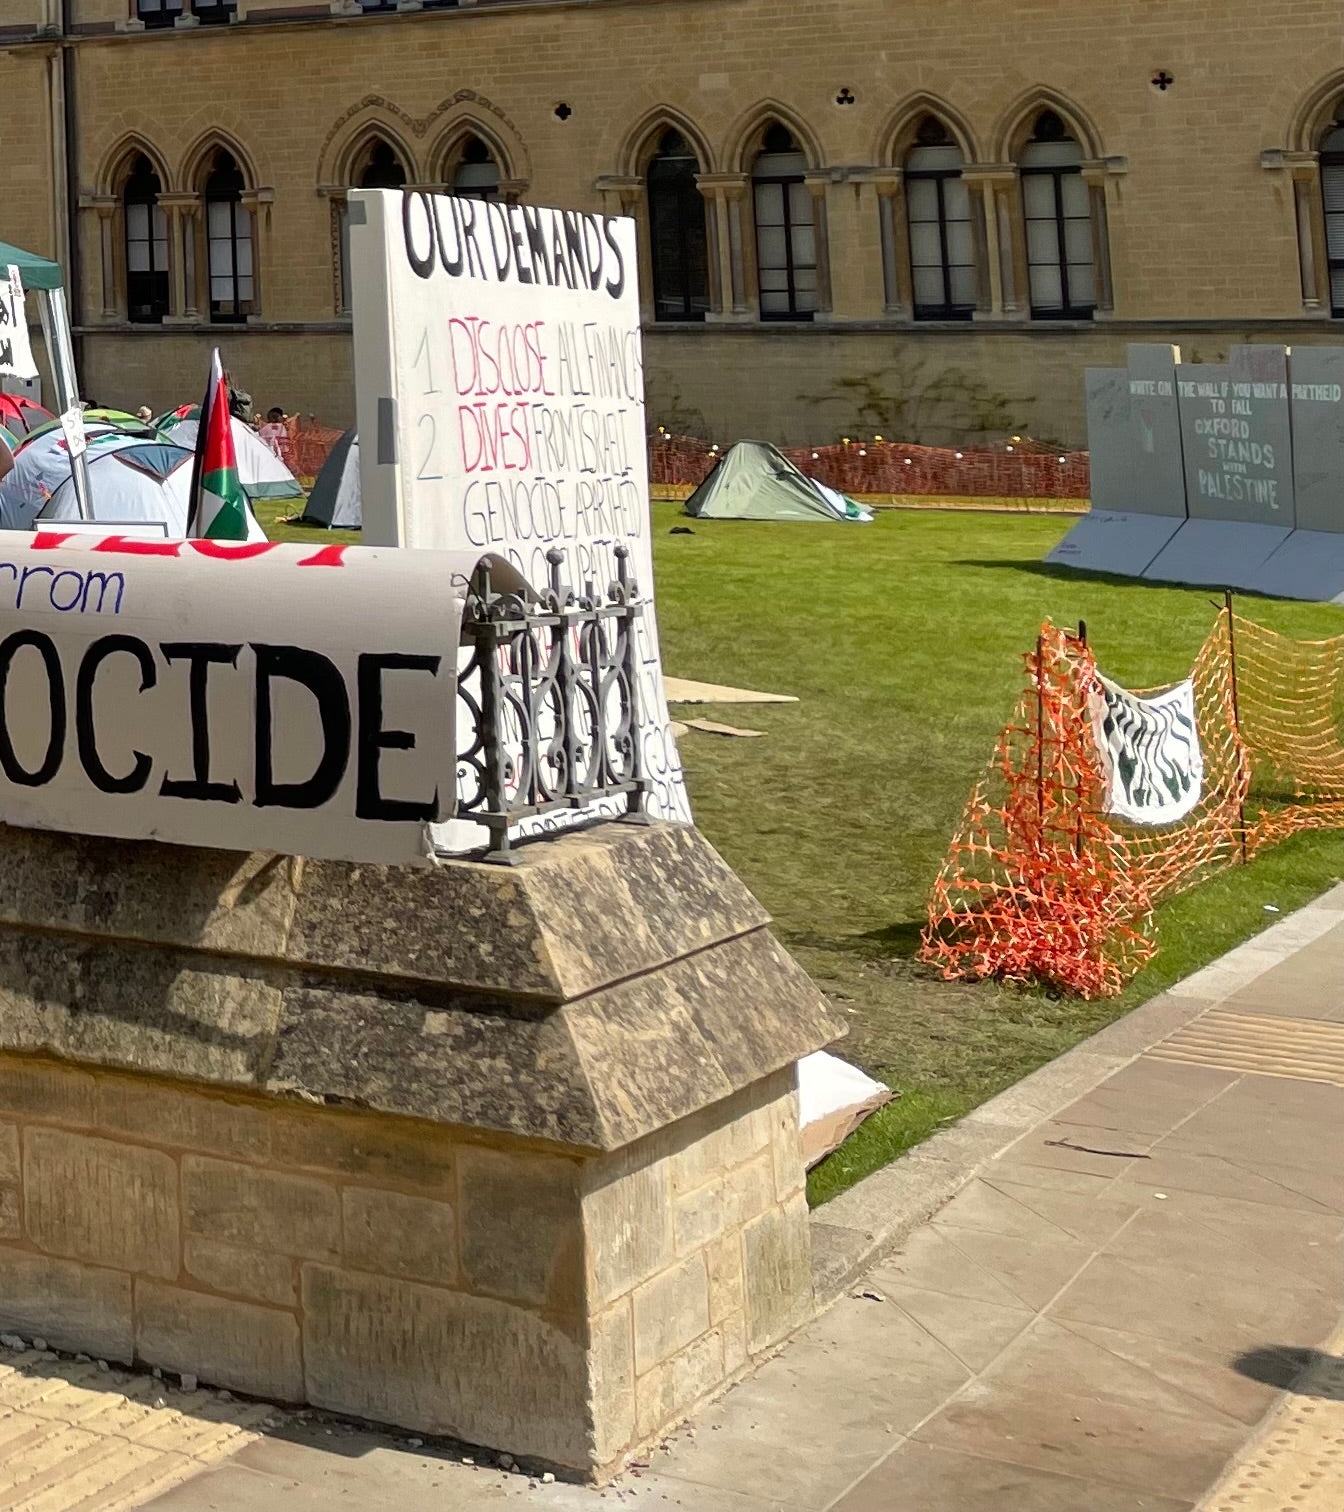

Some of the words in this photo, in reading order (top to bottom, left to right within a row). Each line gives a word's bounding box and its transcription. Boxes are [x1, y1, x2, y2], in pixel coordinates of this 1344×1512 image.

[402, 191, 488, 281] OUR
[486, 202, 625, 299] DEMANDS
[412, 327, 442, 396] 1
[448, 316, 555, 396] DISCLOSE
[1158, 381, 1172, 396] ON
[1177, 381, 1196, 397] THE
[1197, 382, 1219, 398] WALL
[1231, 382, 1252, 398] YOU
[1253, 383, 1278, 399] WANT
[1210, 399, 1226, 413] TO
[1231, 399, 1253, 415] FALL
[417, 414, 443, 480] 2
[458, 402, 533, 473] DIVEST
[532, 403, 579, 474] FROM
[1195, 418, 1250, 439] OXFORD
[1208, 438, 1274, 469] STANDS
[1198, 469, 1280, 509] PALESTINE
[464, 477, 573, 546] GENOCIDE
